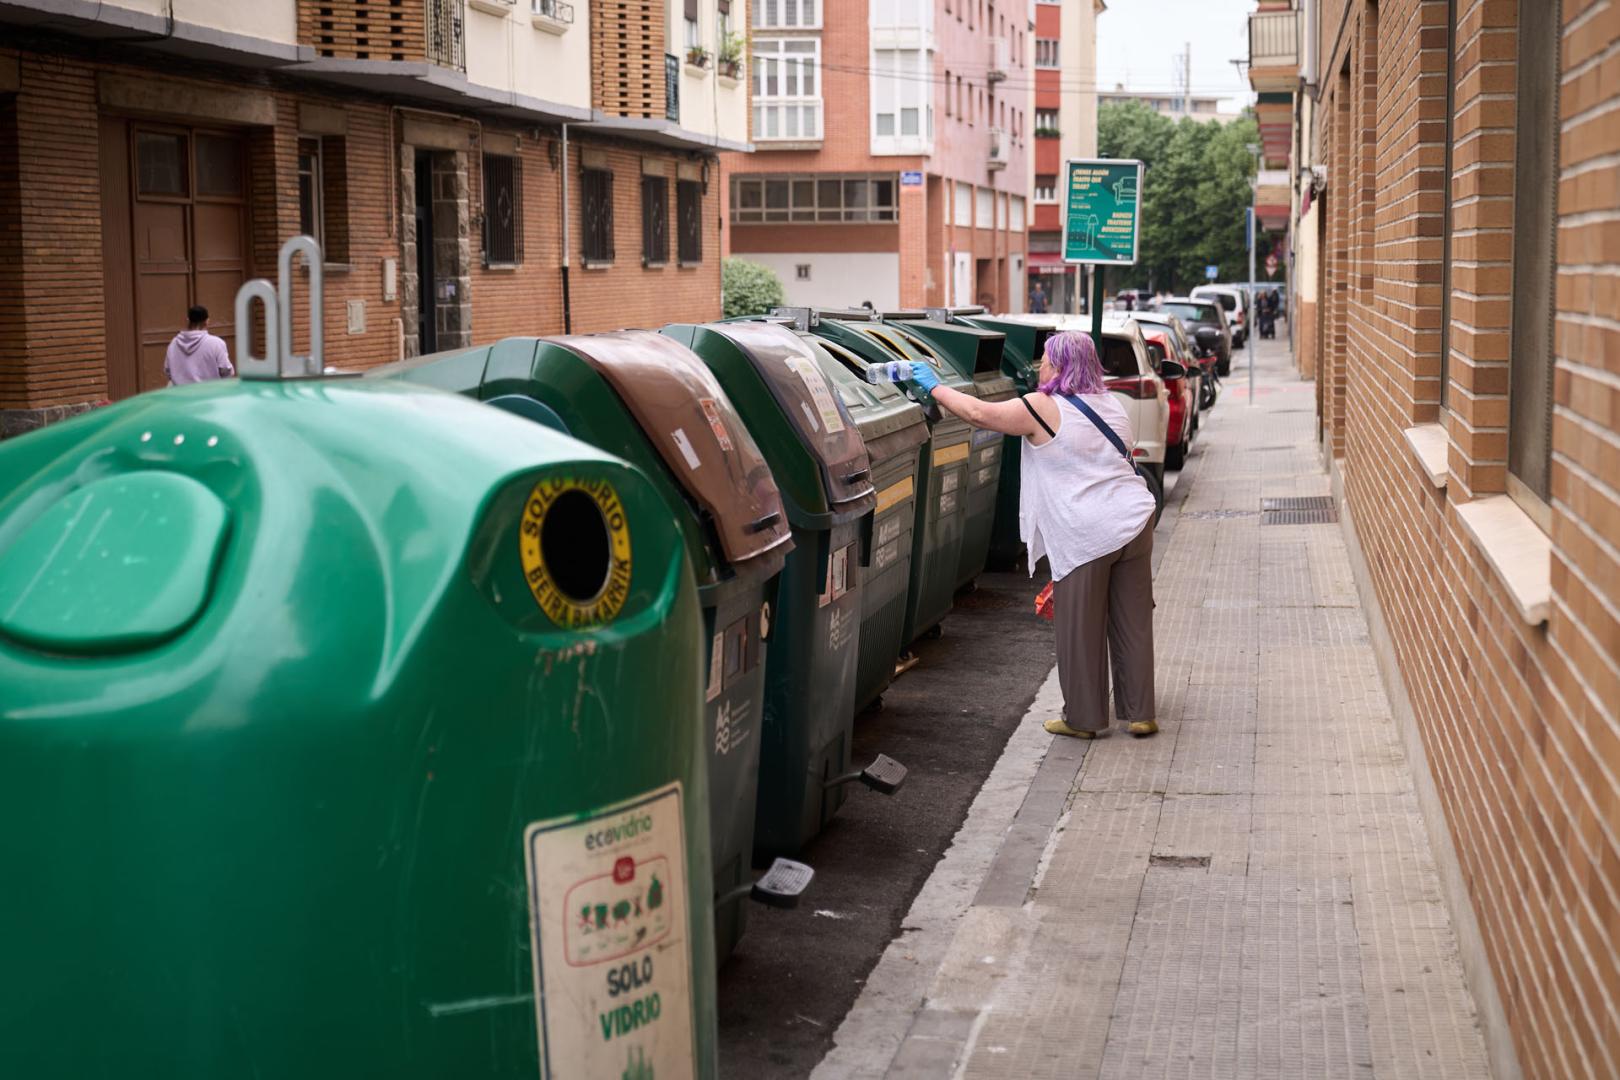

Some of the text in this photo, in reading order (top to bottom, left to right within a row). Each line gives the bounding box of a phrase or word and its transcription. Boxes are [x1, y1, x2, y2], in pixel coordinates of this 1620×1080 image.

[524, 477, 564, 538] SOLO
[585, 815, 652, 851] ecovidrio
[607, 954, 653, 998] SOLO
[599, 991, 661, 1041] VIDRIO
